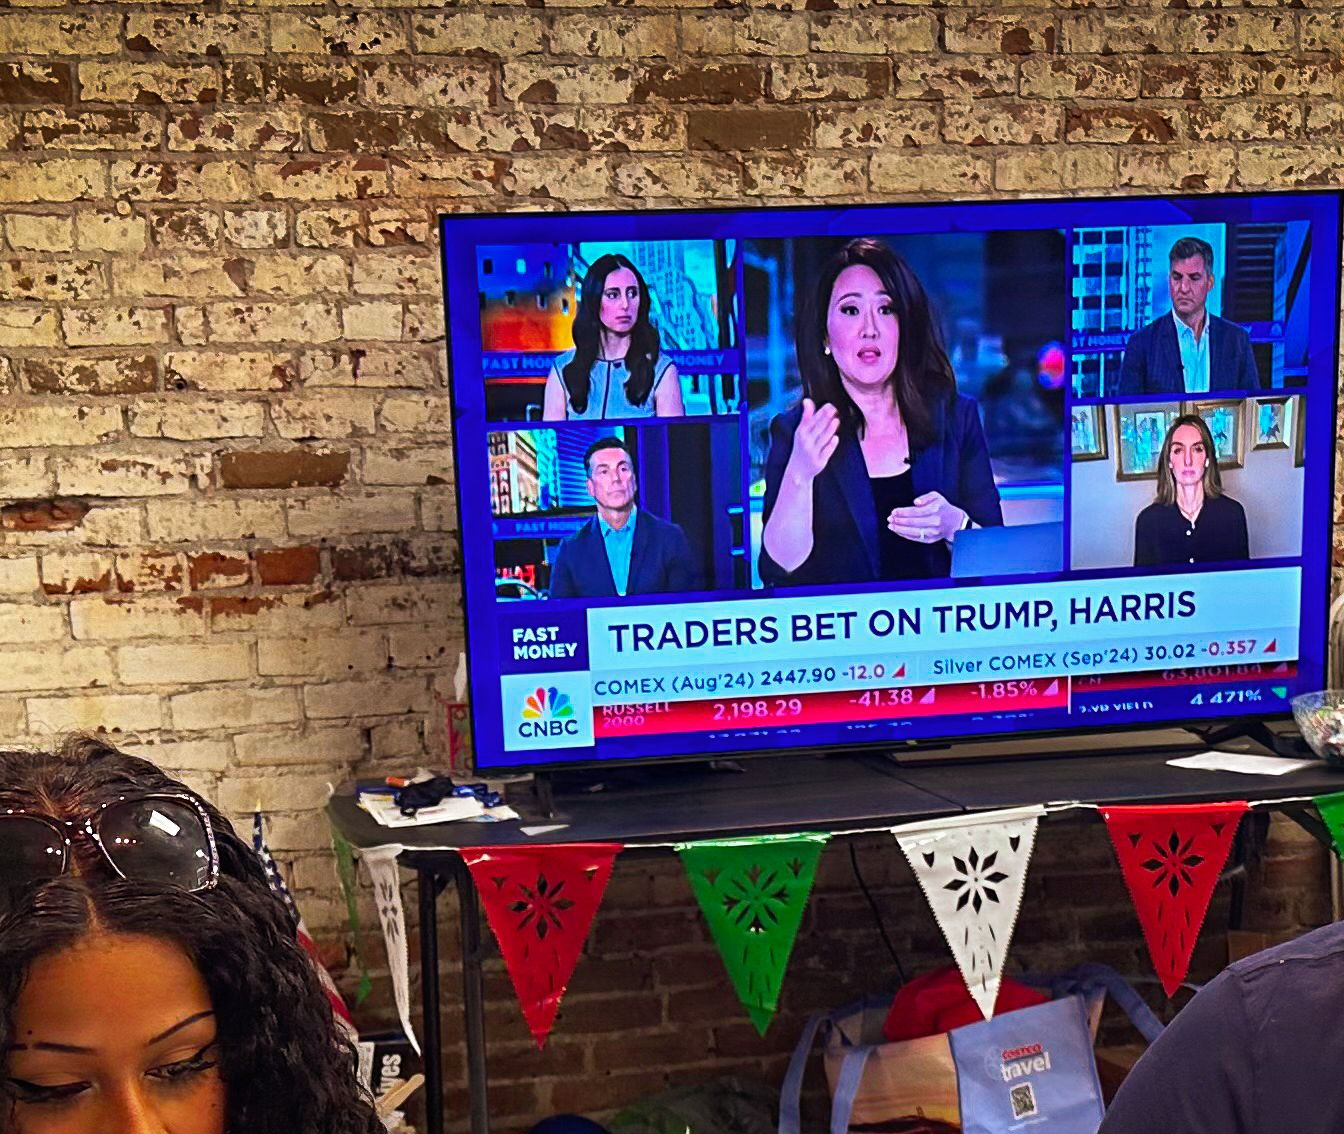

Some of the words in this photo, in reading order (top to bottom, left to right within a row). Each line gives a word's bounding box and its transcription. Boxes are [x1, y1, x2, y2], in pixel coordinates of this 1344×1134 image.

[482, 356, 519, 371] FAST
[608, 615, 779, 653] TRADERS
[791, 611, 858, 642] BET
[868, 607, 921, 637] ON
[932, 600, 1058, 634] TRUMP,
[1069, 590, 1197, 625] HARRIS
[512, 625, 560, 643] FAST
[513, 642, 578, 661] MONEY
[594, 676, 666, 696] COMEX
[671, 672, 755, 694] (Aug'24)
[760, 666, 836, 687] 2447.90
[841, 663, 886, 680] -12.0
[933, 657, 983, 675] Silver
[988, 652, 1057, 671] COMEX
[1062, 647, 1139, 669] (Sep'24)
[1144, 643, 1196, 661] 30.02
[1200, 639, 1257, 656] -0.357
[713, 698, 803, 721] 2,198.29
[849, 688, 913, 708] -41.38
[970, 680, 1038, 700] -1.85%
[1190, 688, 1262, 706] 4471%
[518, 719, 580, 738] CNBC
[999, 1051, 1052, 1082] travel
